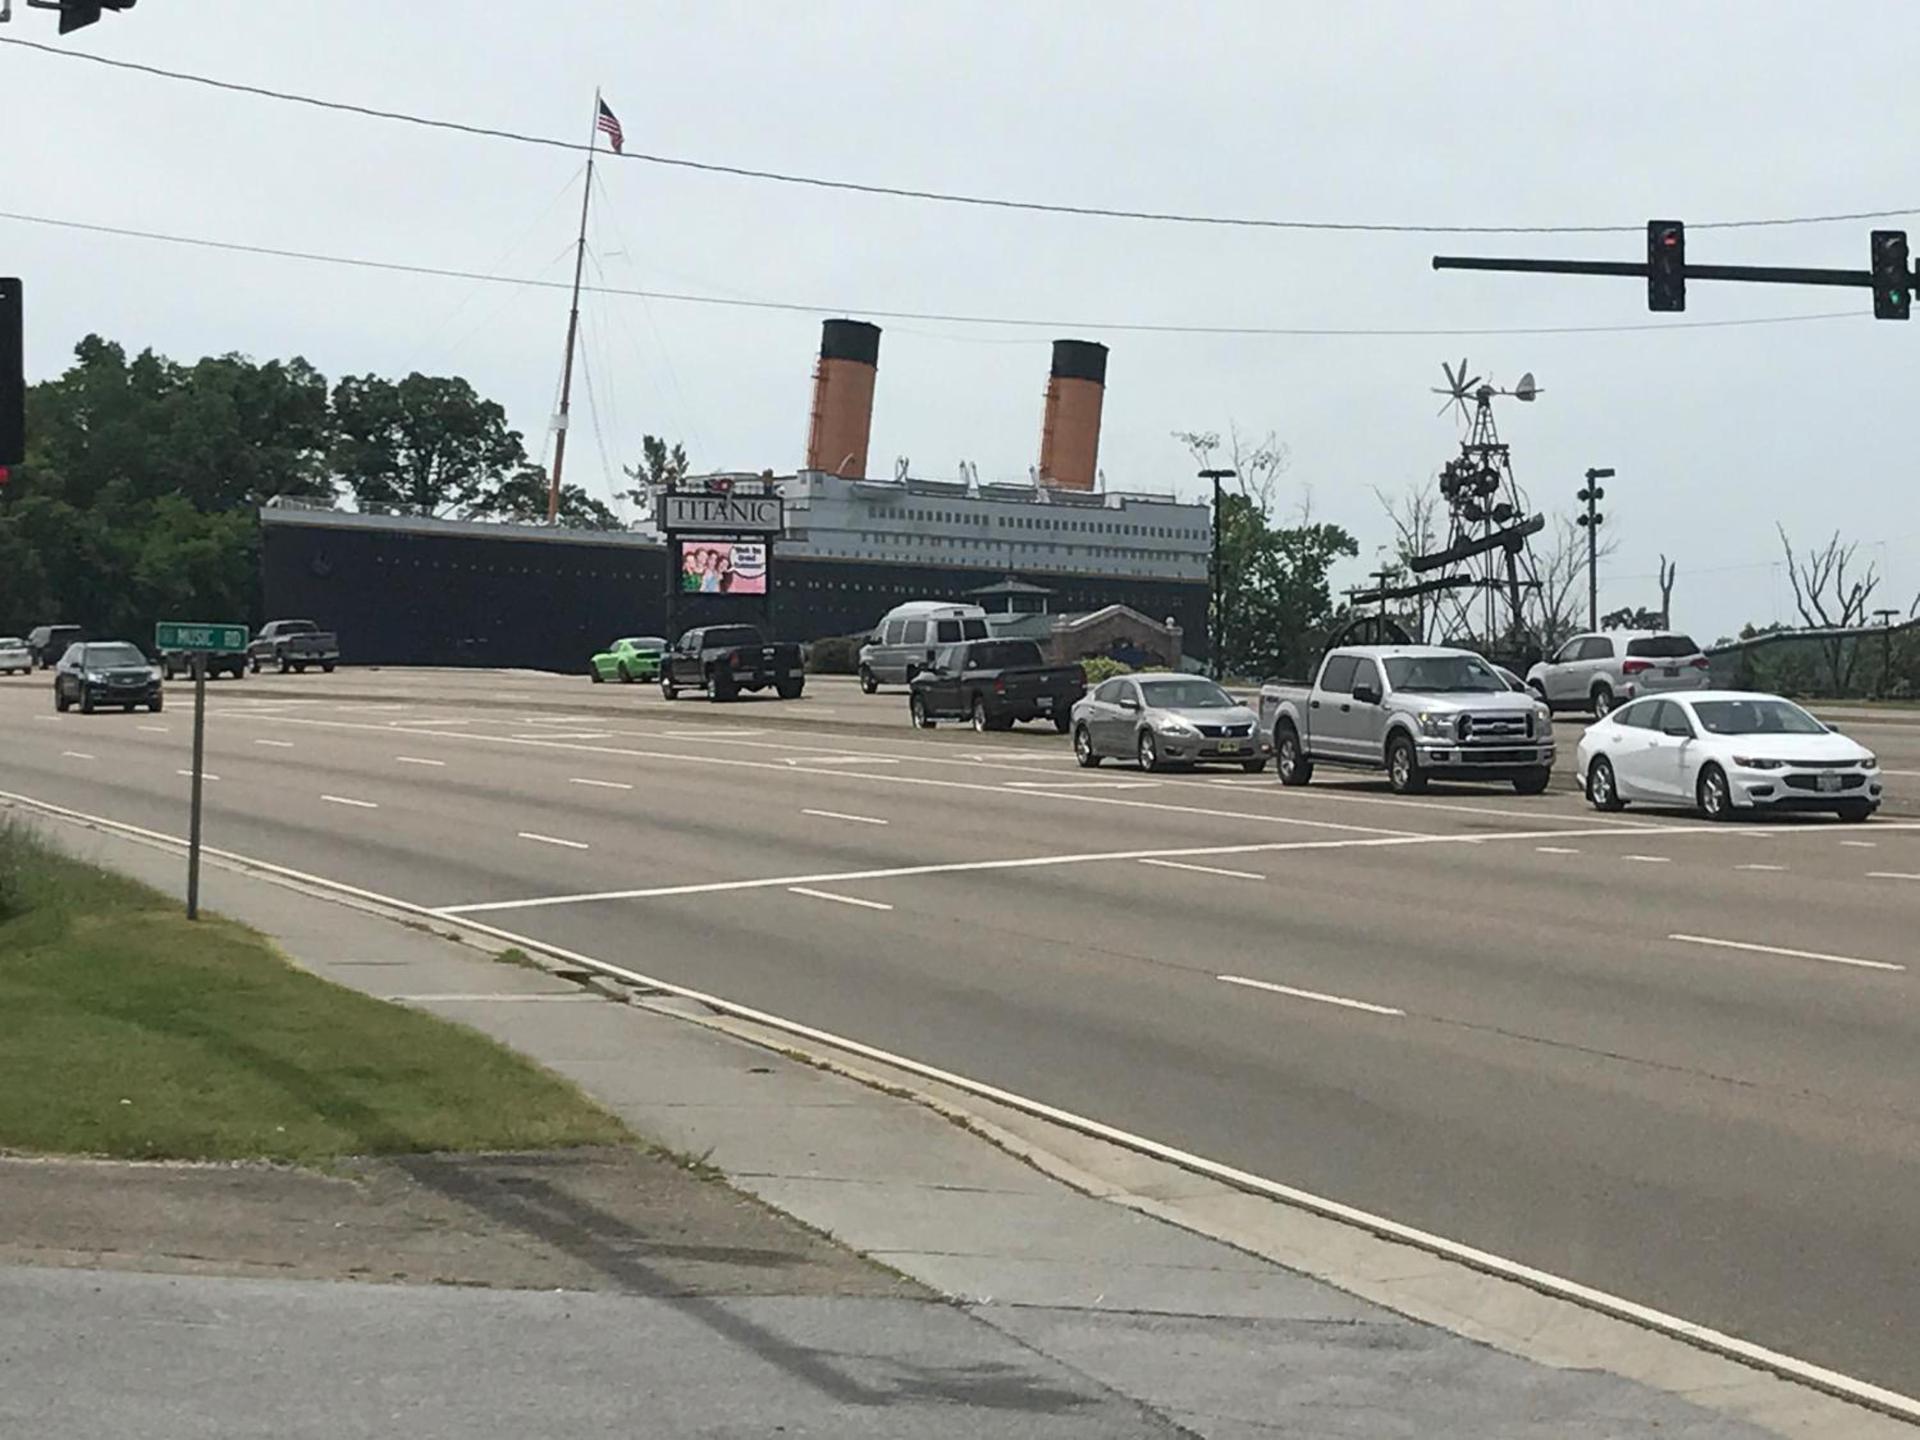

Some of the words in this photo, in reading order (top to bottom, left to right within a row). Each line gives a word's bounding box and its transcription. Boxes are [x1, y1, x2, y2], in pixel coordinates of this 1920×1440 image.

[672, 500, 775, 522] TITANIC
[177, 628, 214, 646] MUSIC
[224, 631, 241, 647] RD
